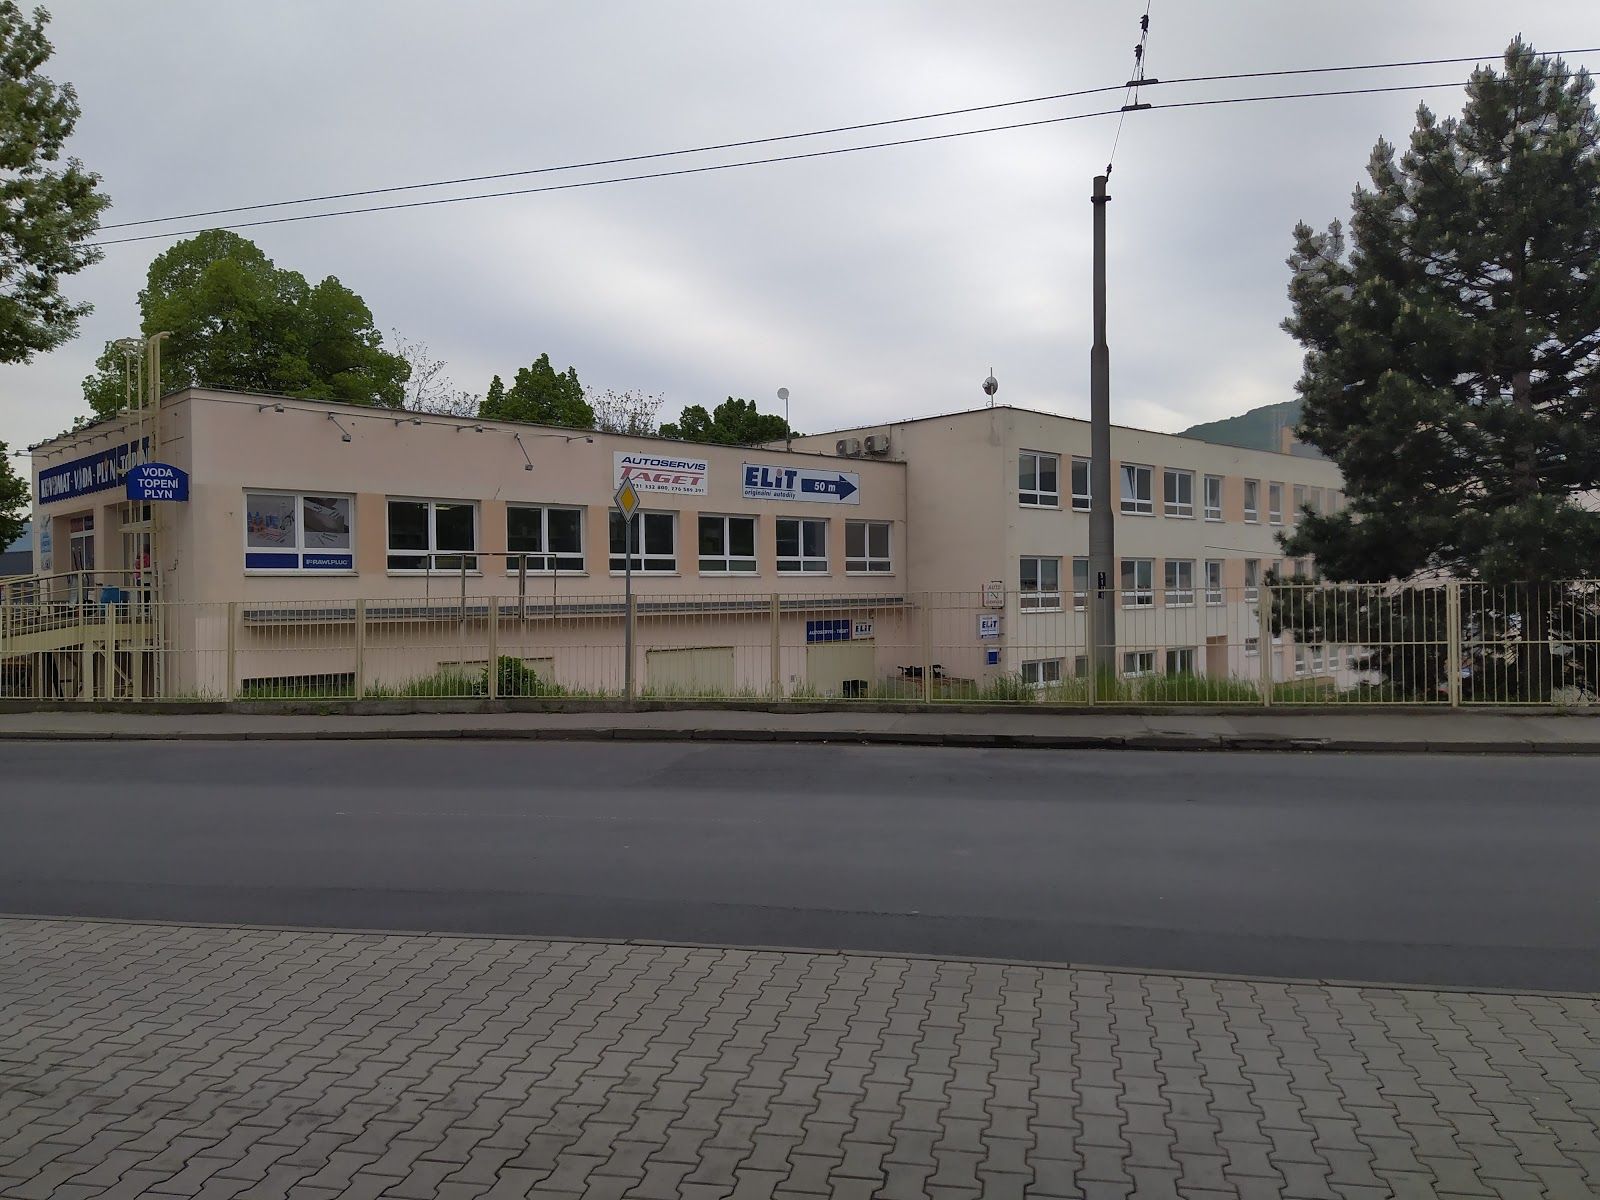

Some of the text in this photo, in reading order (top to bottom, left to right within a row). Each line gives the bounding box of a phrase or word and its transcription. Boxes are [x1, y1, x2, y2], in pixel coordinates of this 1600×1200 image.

[96, 457, 116, 485] PLYN
[120, 447, 149, 478] TOPN
[621, 456, 706, 471] AUTOSERVIS
[142, 467, 174, 478] VODA
[620, 466, 705, 486] TAGET
[137, 478, 179, 489] TOPENÍ
[814, 481, 836, 492] 50 m
[144, 489, 173, 499] PLYN
